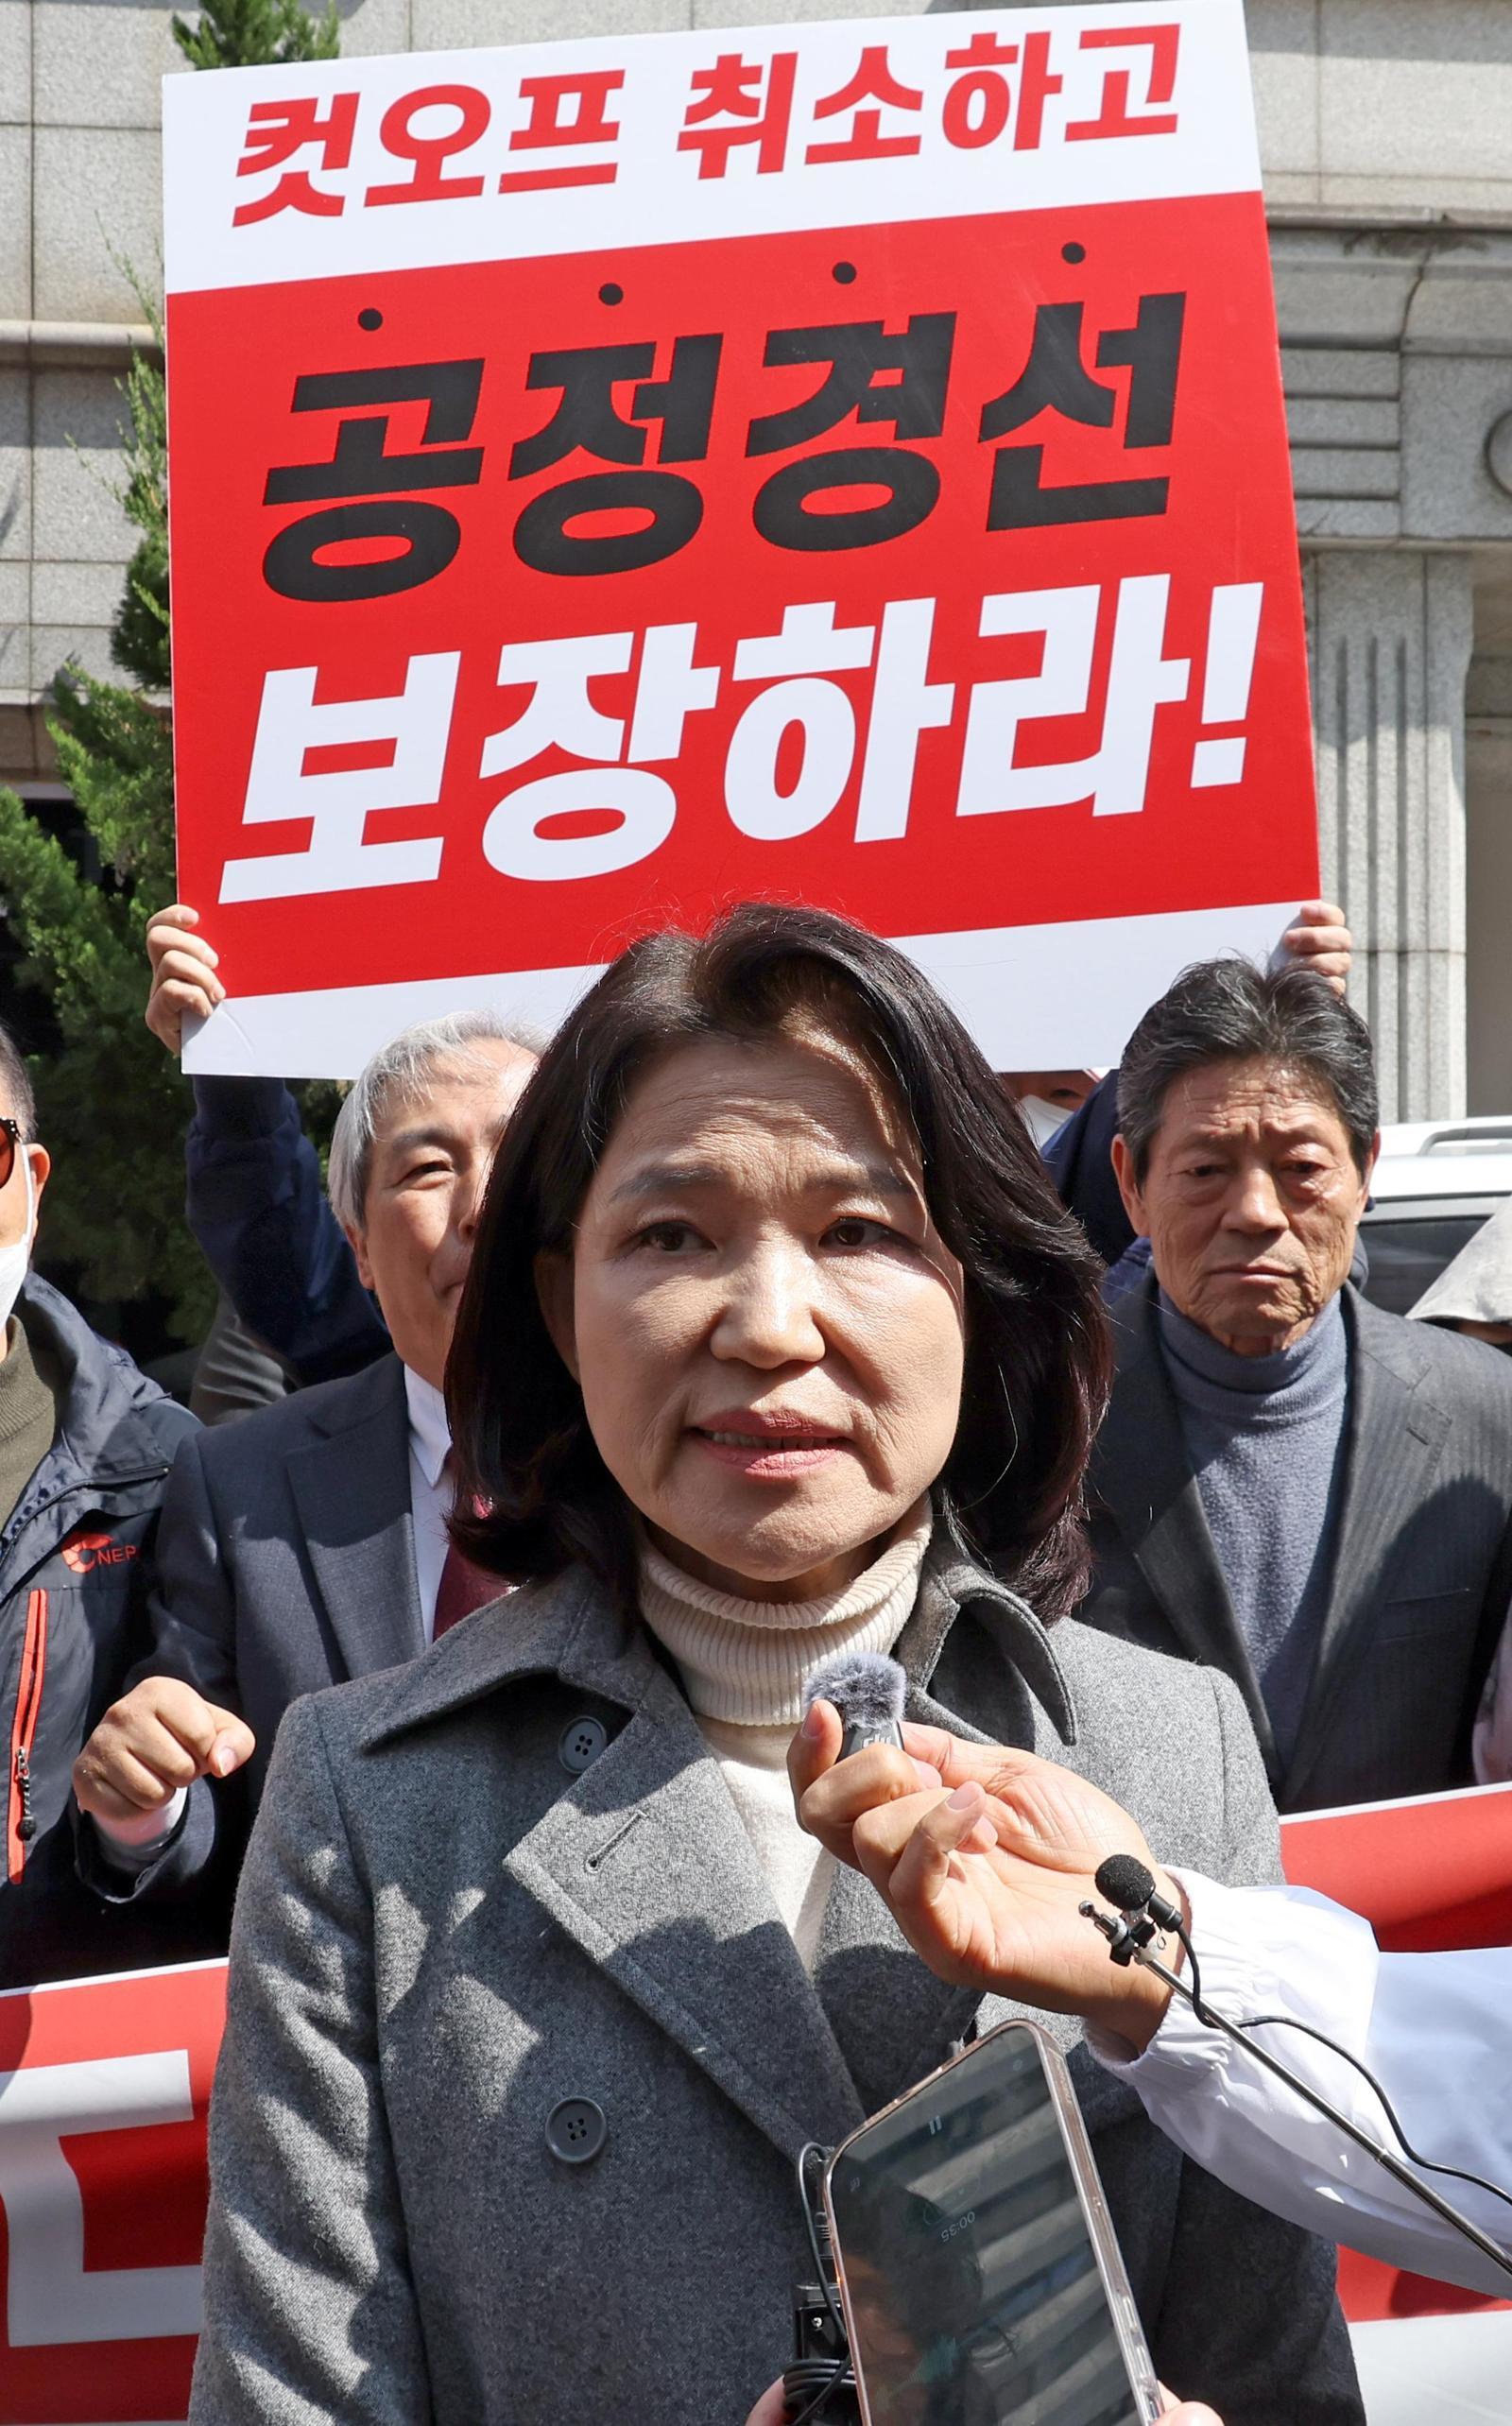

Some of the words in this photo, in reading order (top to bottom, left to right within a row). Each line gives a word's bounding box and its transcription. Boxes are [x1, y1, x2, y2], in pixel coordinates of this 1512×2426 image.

[232, 69, 626, 227] 컷오프
[678, 24, 1180, 180] 취소하고
[263, 291, 1187, 603] 공정경선
[218, 573, 1264, 904] 보장하라!
[940, 2211, 976, 2243] 00:35
